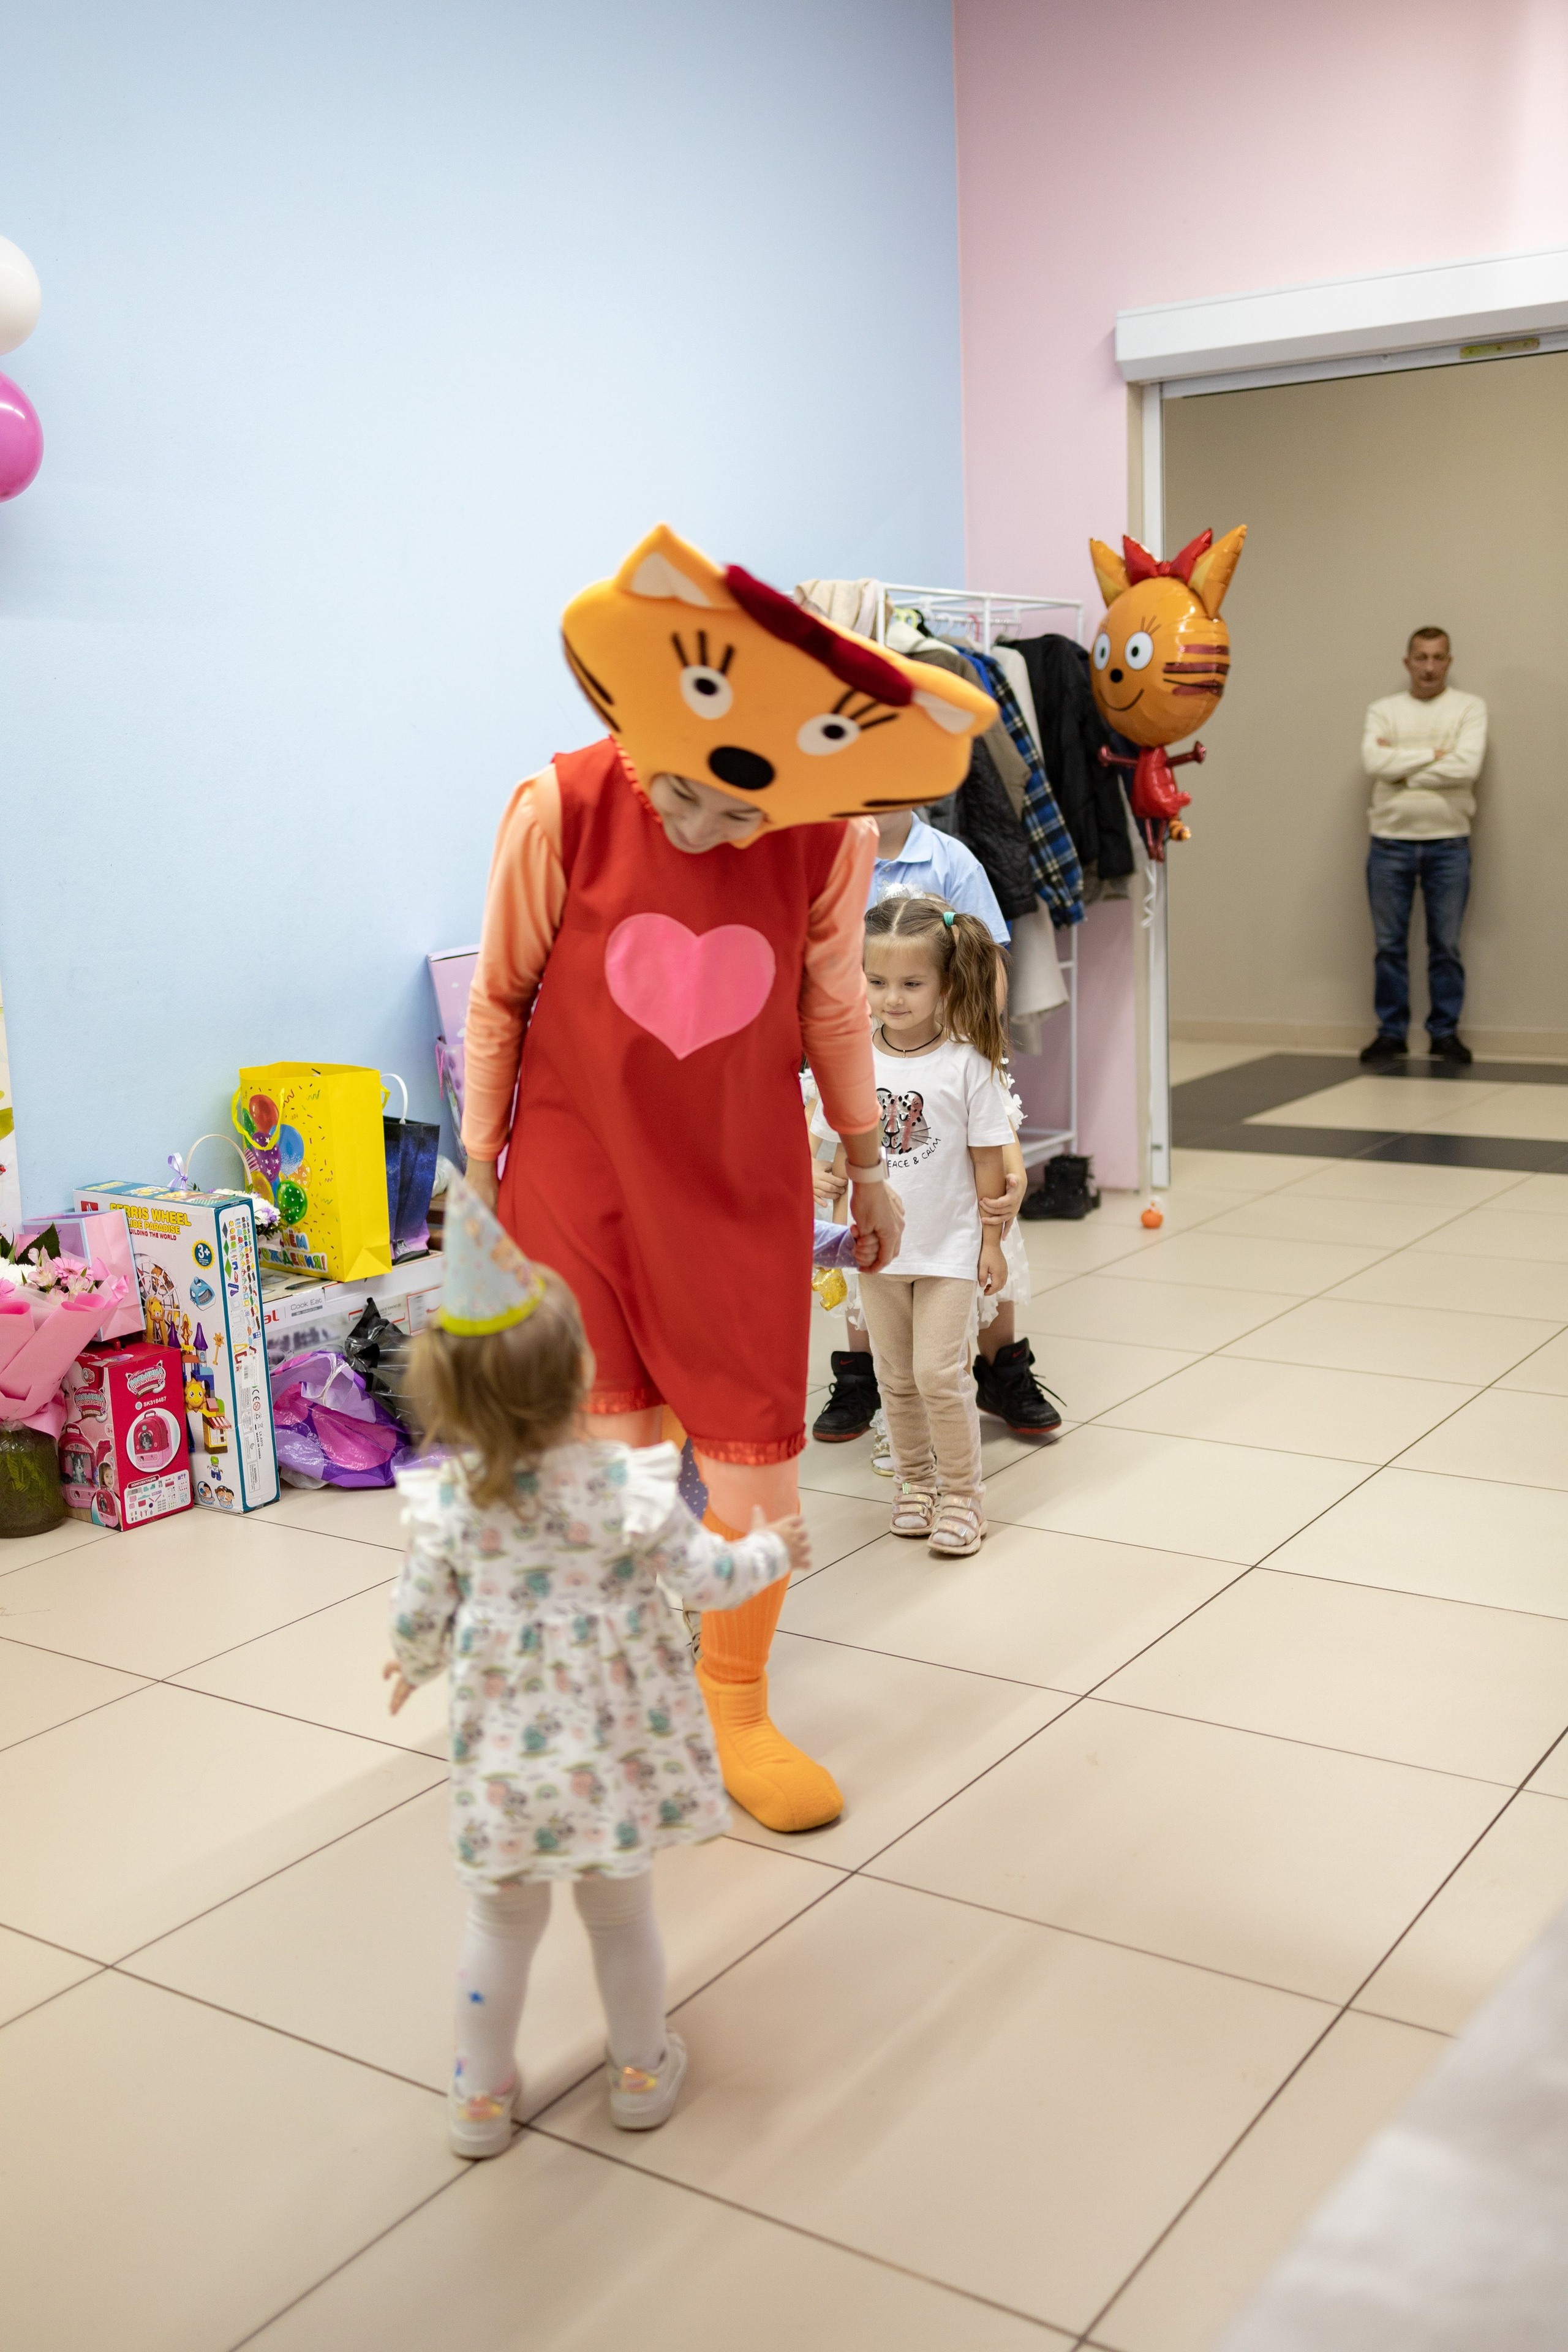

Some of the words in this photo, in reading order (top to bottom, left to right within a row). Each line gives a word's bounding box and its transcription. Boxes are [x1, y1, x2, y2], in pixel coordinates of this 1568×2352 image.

[887, 1159, 910, 1168] EACE
[913, 1156, 919, 1165] &
[921, 1138, 941, 1159] CALM
[151, 1208, 192, 1226] WHEEL
[144, 1221, 181, 1235] PARADISE
[197, 1244, 210, 1259] 3+
[290, 1301, 309, 1311] Cook
[143, 1396, 167, 1407] SK318487
